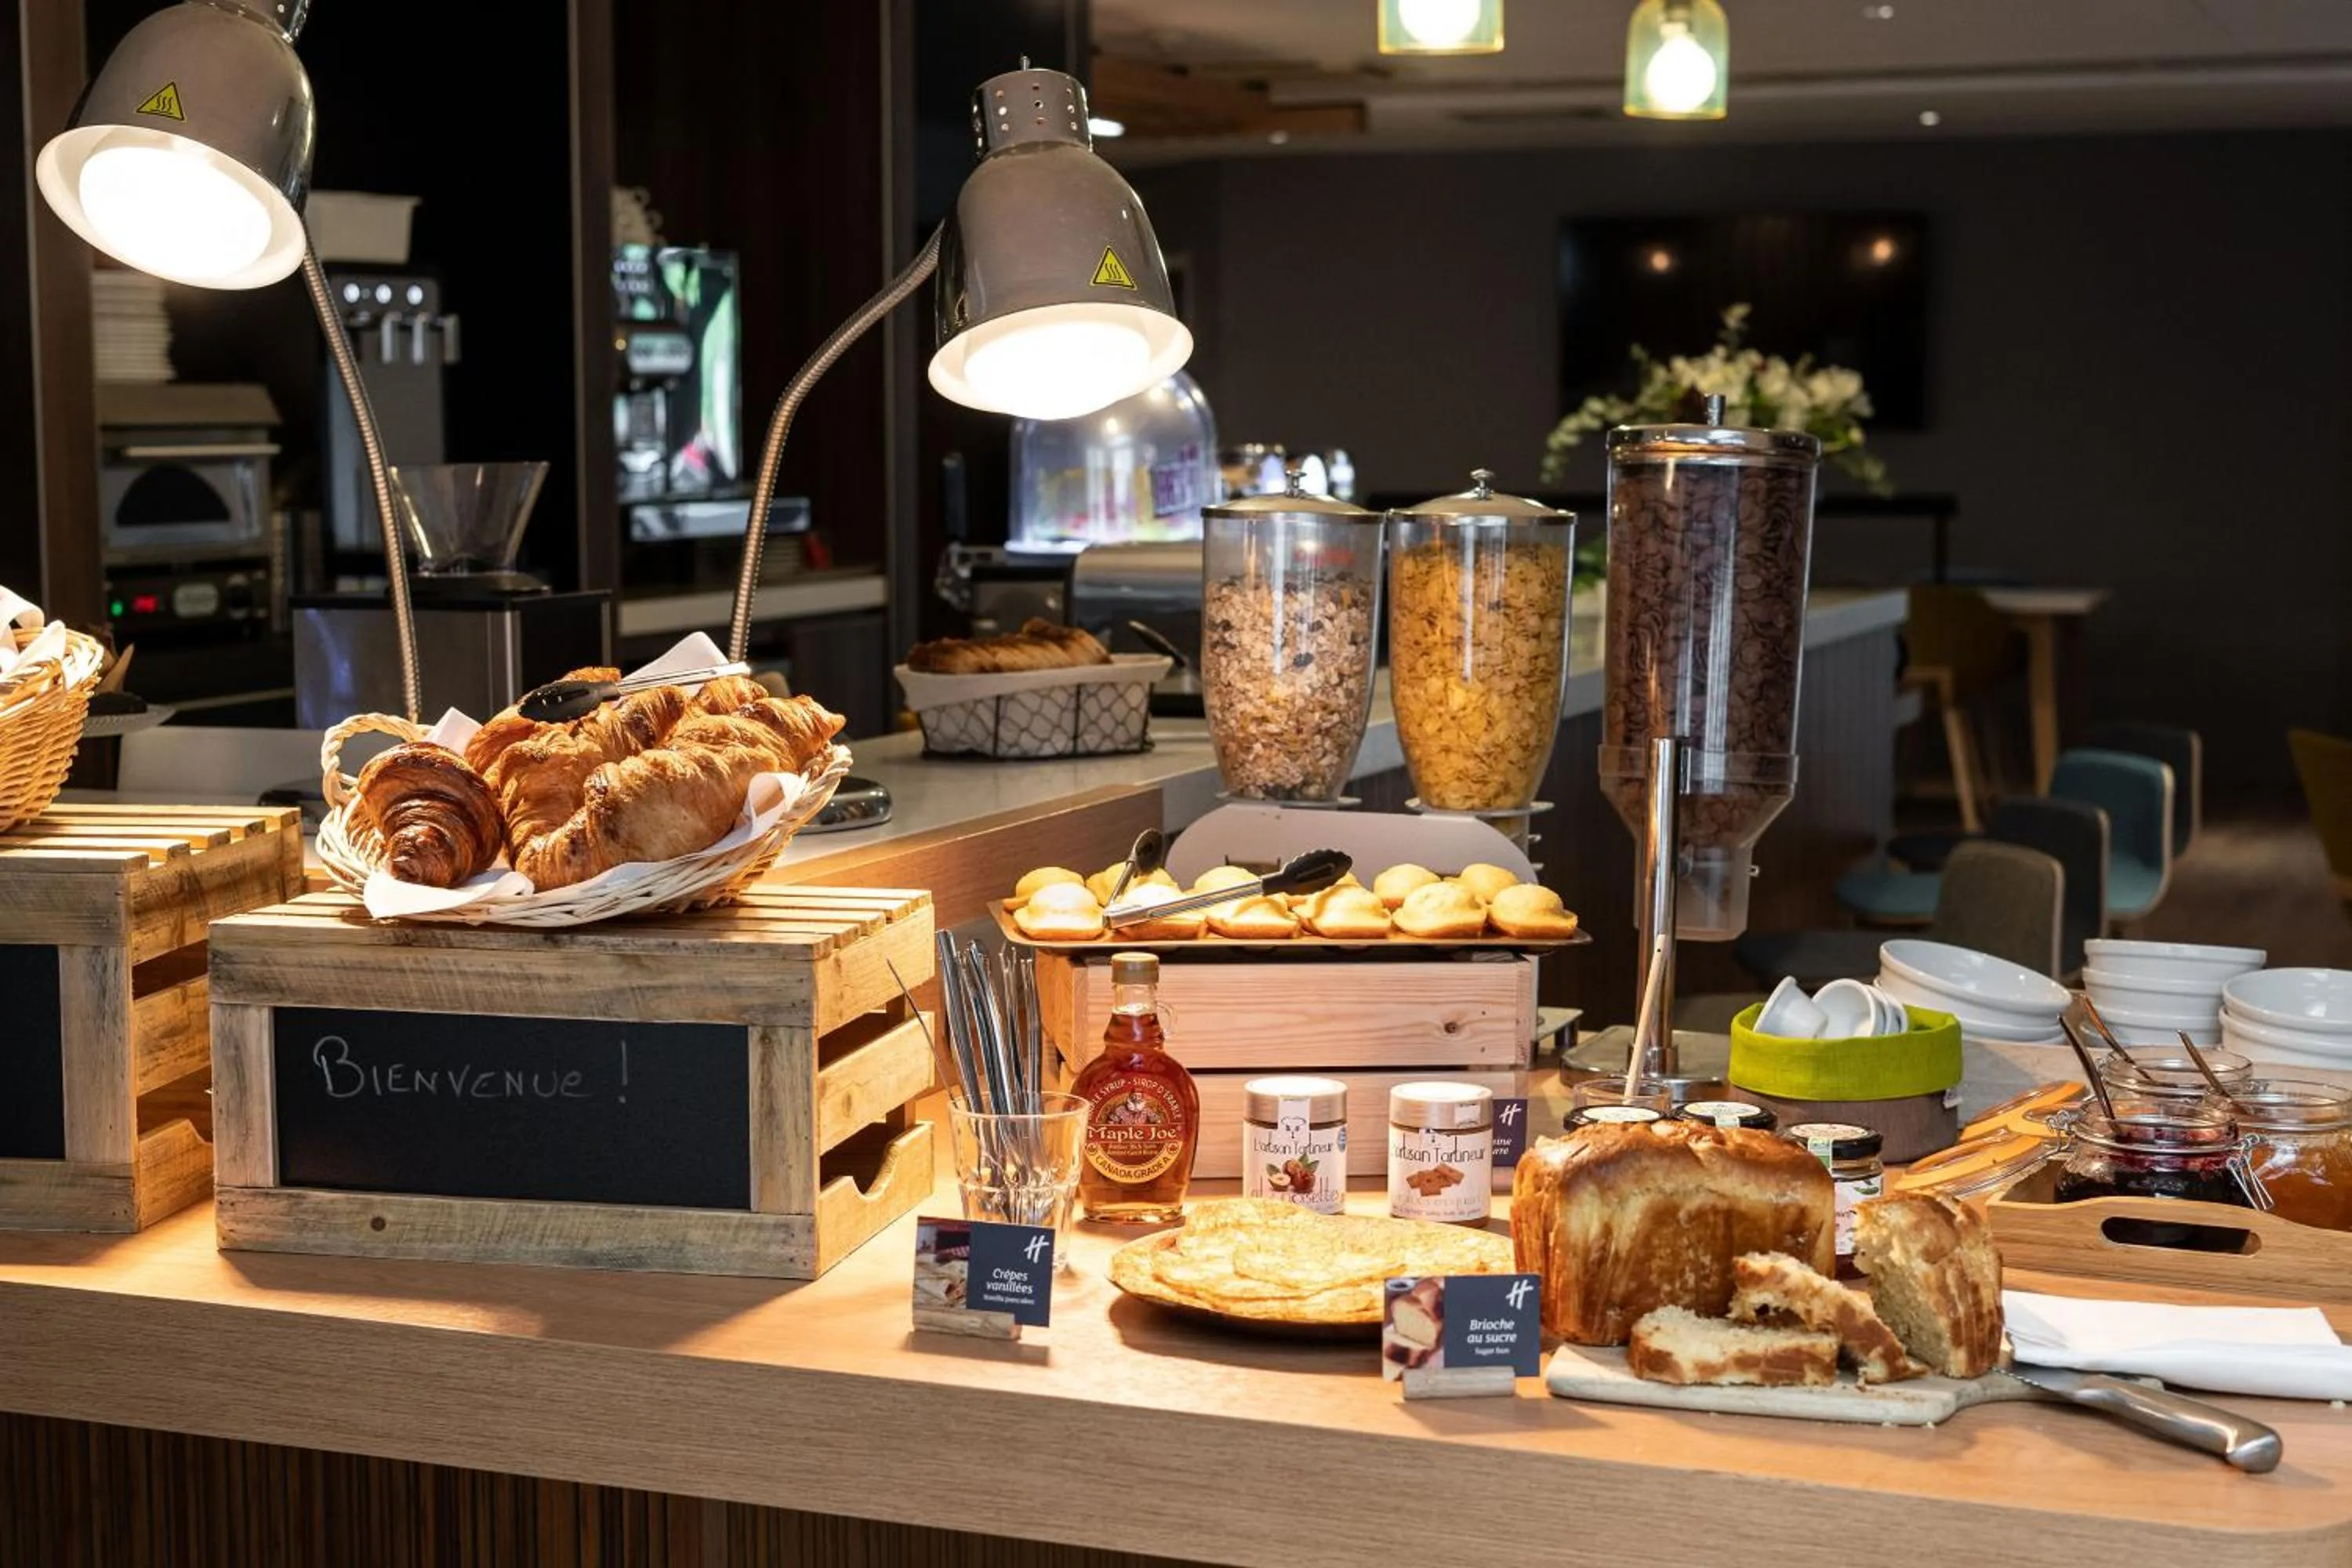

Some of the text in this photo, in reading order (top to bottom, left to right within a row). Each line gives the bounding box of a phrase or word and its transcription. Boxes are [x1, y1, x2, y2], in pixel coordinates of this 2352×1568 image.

[1086, 1125, 1178, 1143] Maple Joe
[1095, 1155, 1133, 1180] CANADA
[1133, 1160, 1163, 1179] GRADE
[1469, 1317, 1515, 1331] Brioche
[1466, 1333, 1518, 1344] au sucre
